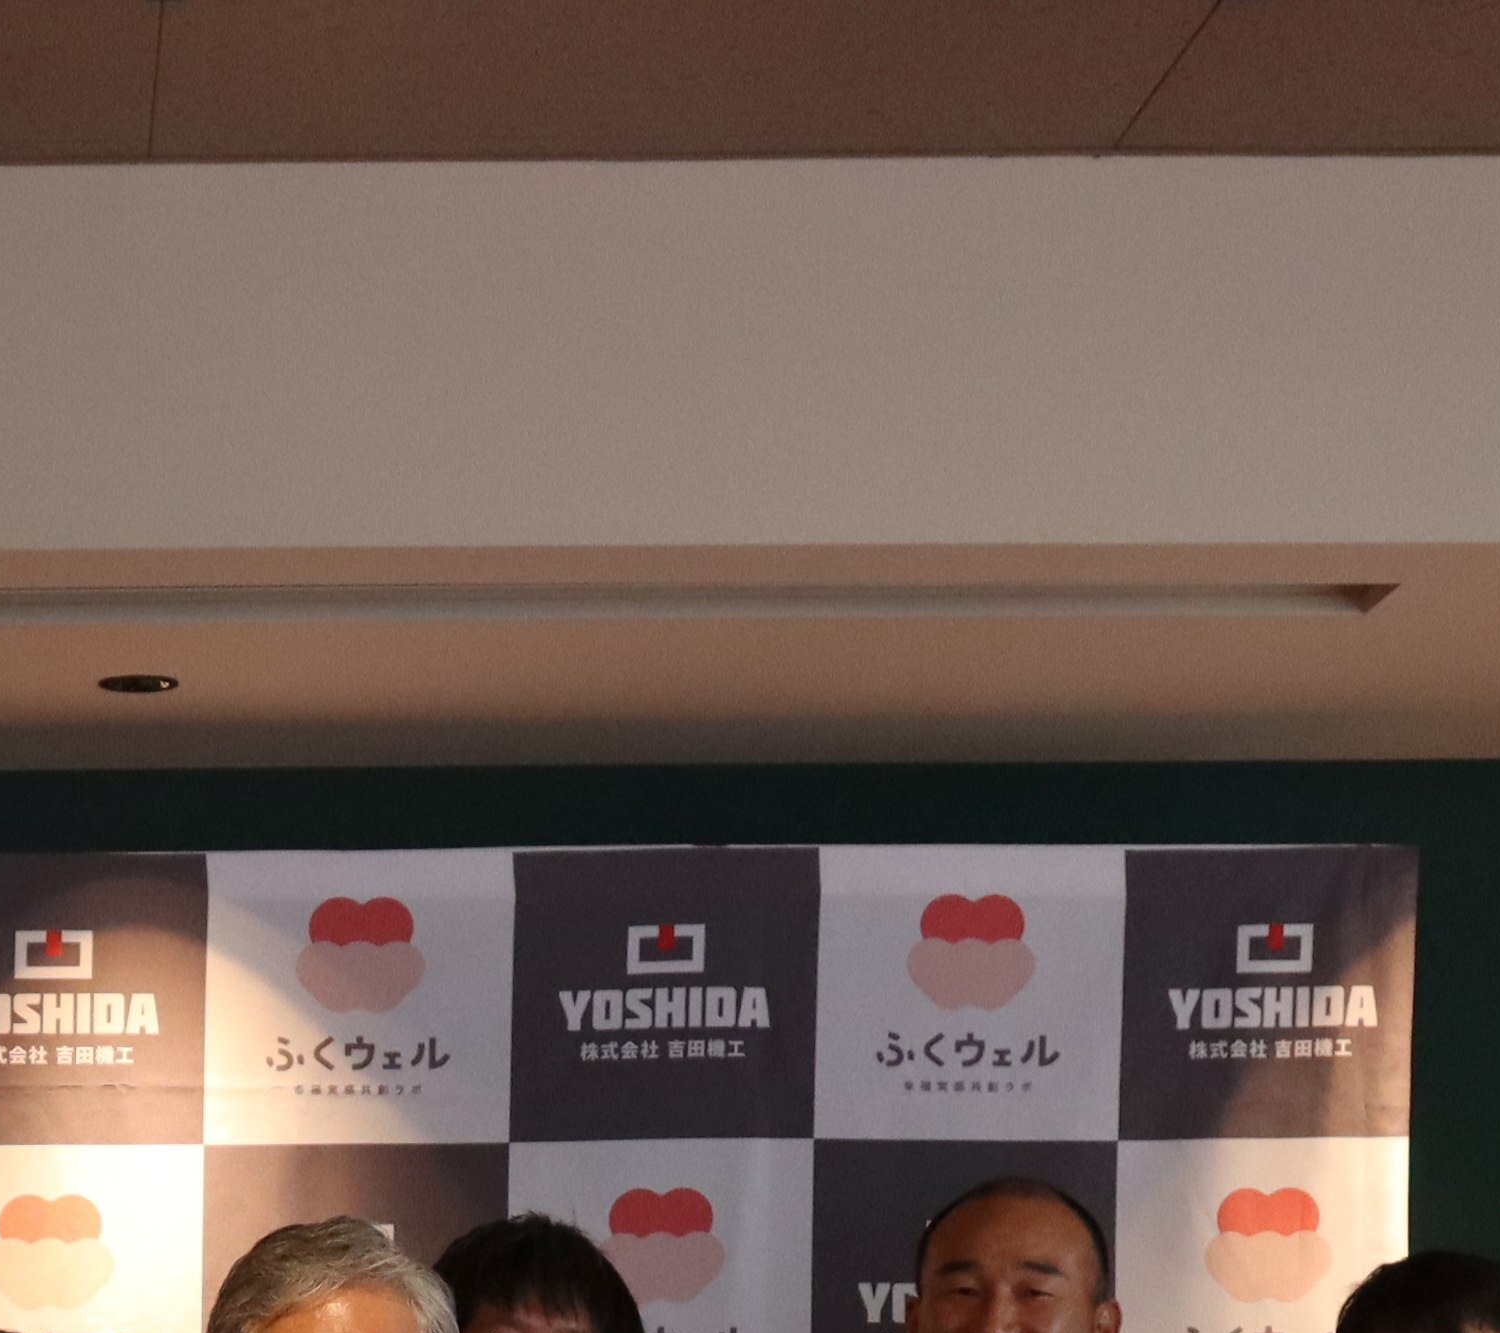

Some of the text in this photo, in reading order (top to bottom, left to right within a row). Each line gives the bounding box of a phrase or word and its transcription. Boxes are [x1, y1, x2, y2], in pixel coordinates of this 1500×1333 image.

[558, 985, 772, 1032] YOSHIDA
[1168, 984, 1379, 1030] YOSHIDA
[55, 1044, 135, 1066] 吉田機工
[266, 1035, 450, 1071] ふくウェル
[579, 1038, 747, 1061] 株式会社 吉田機工
[876, 1032, 1060, 1067] ふくウェル
[1188, 1037, 1353, 1060] 株式会社 吉田機工
